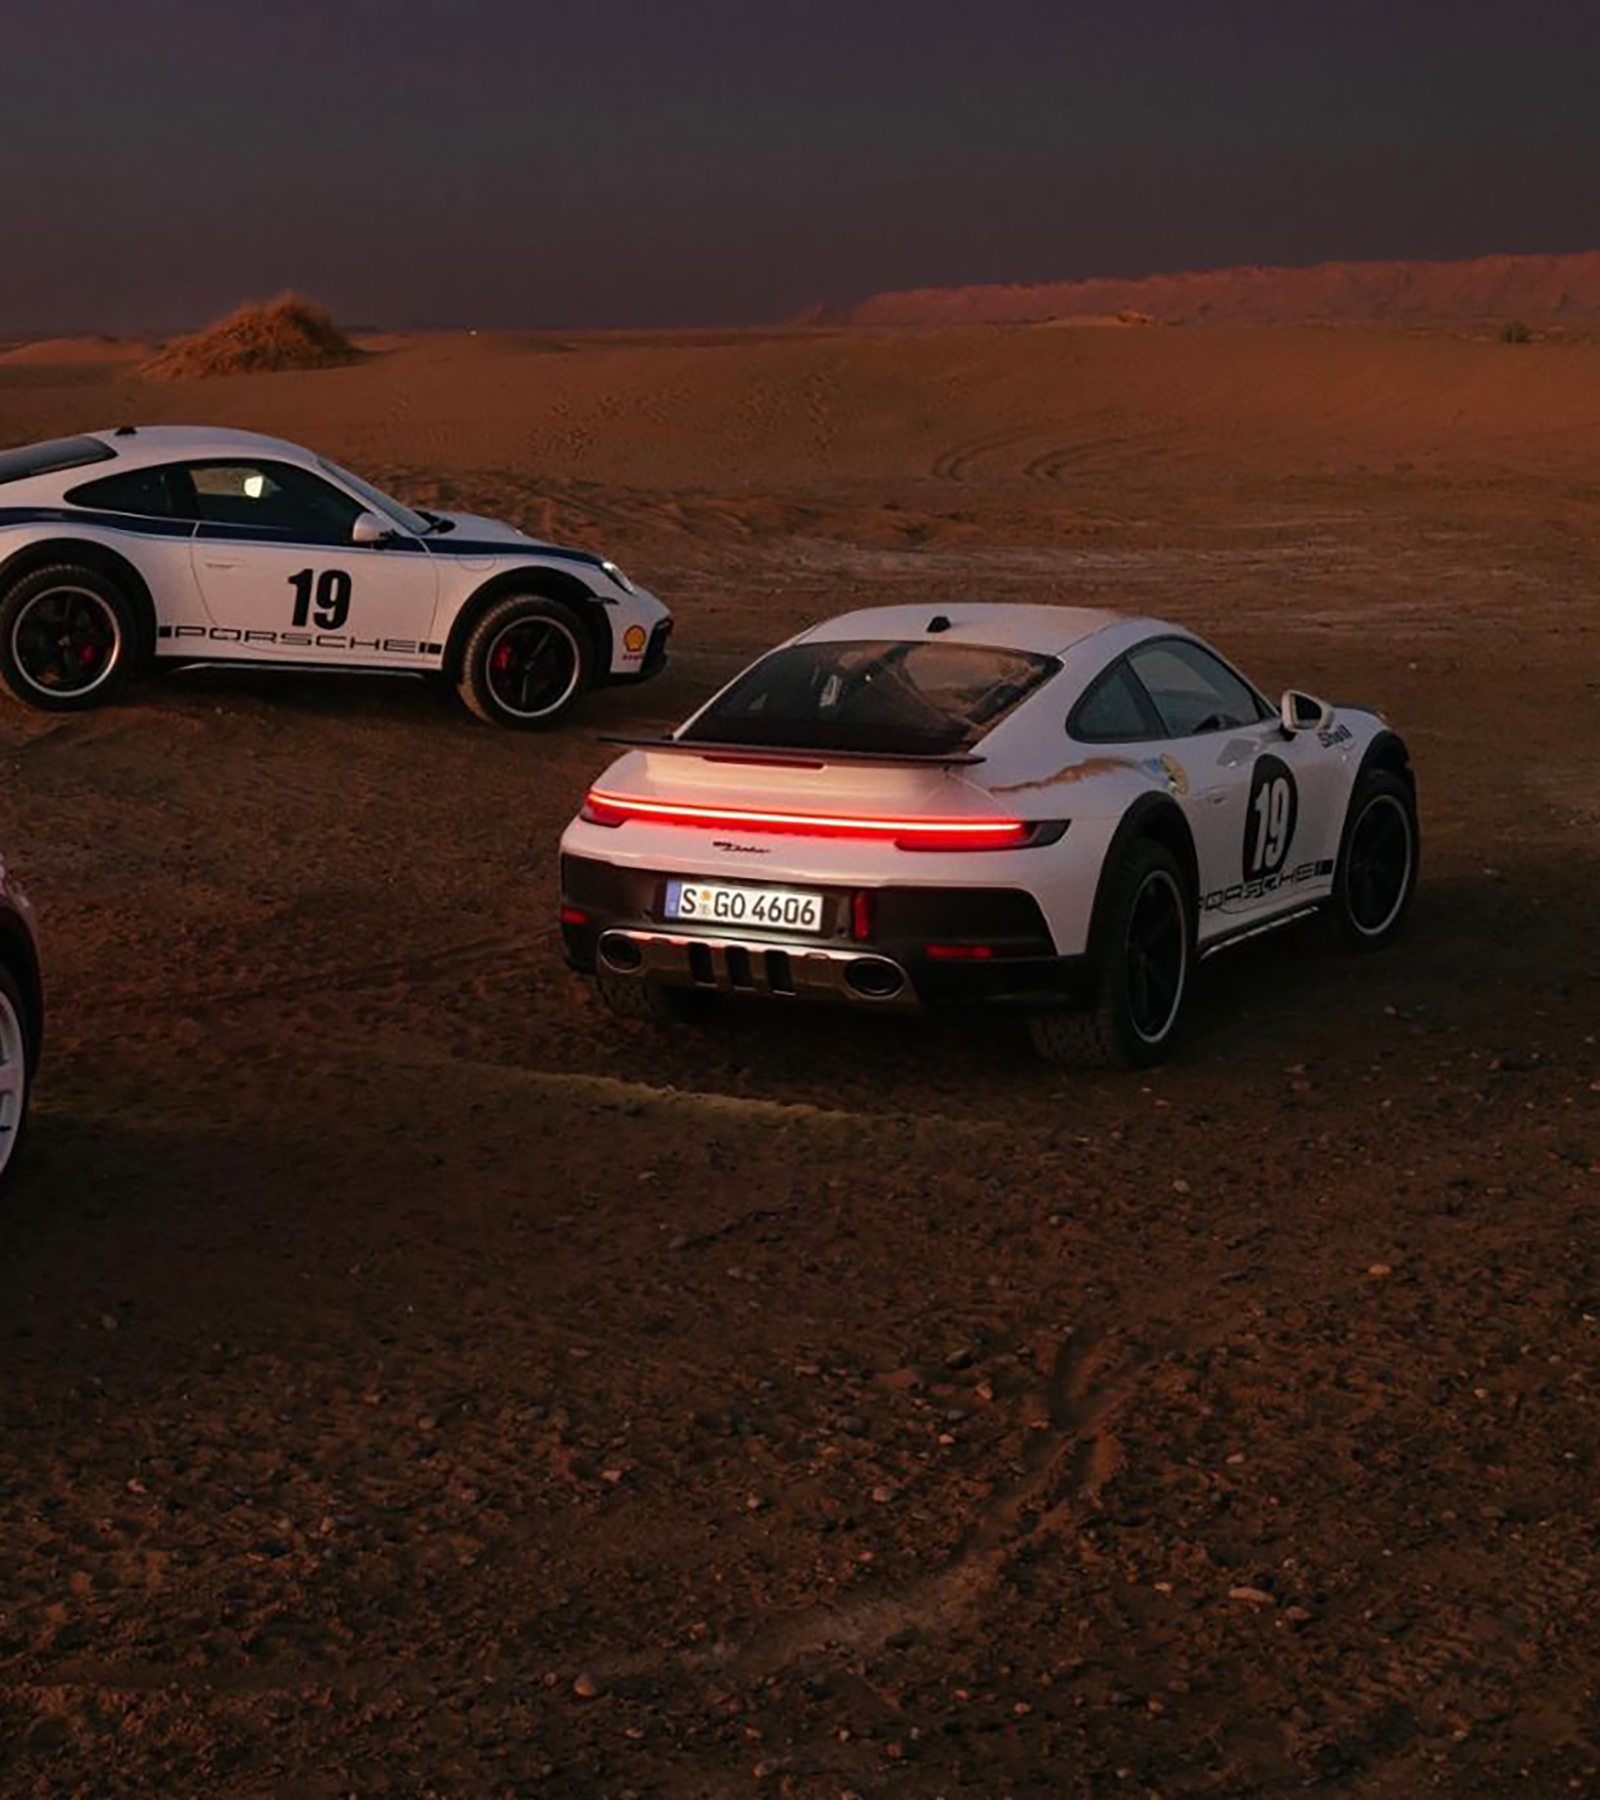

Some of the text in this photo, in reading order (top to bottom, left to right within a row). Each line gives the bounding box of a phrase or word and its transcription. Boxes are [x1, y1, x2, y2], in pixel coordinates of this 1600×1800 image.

[287, 568, 352, 630] 19
[174, 625, 415, 654] PORSCHE
[1253, 776, 1290, 872] 19
[681, 888, 816, 926] S GO 4606
